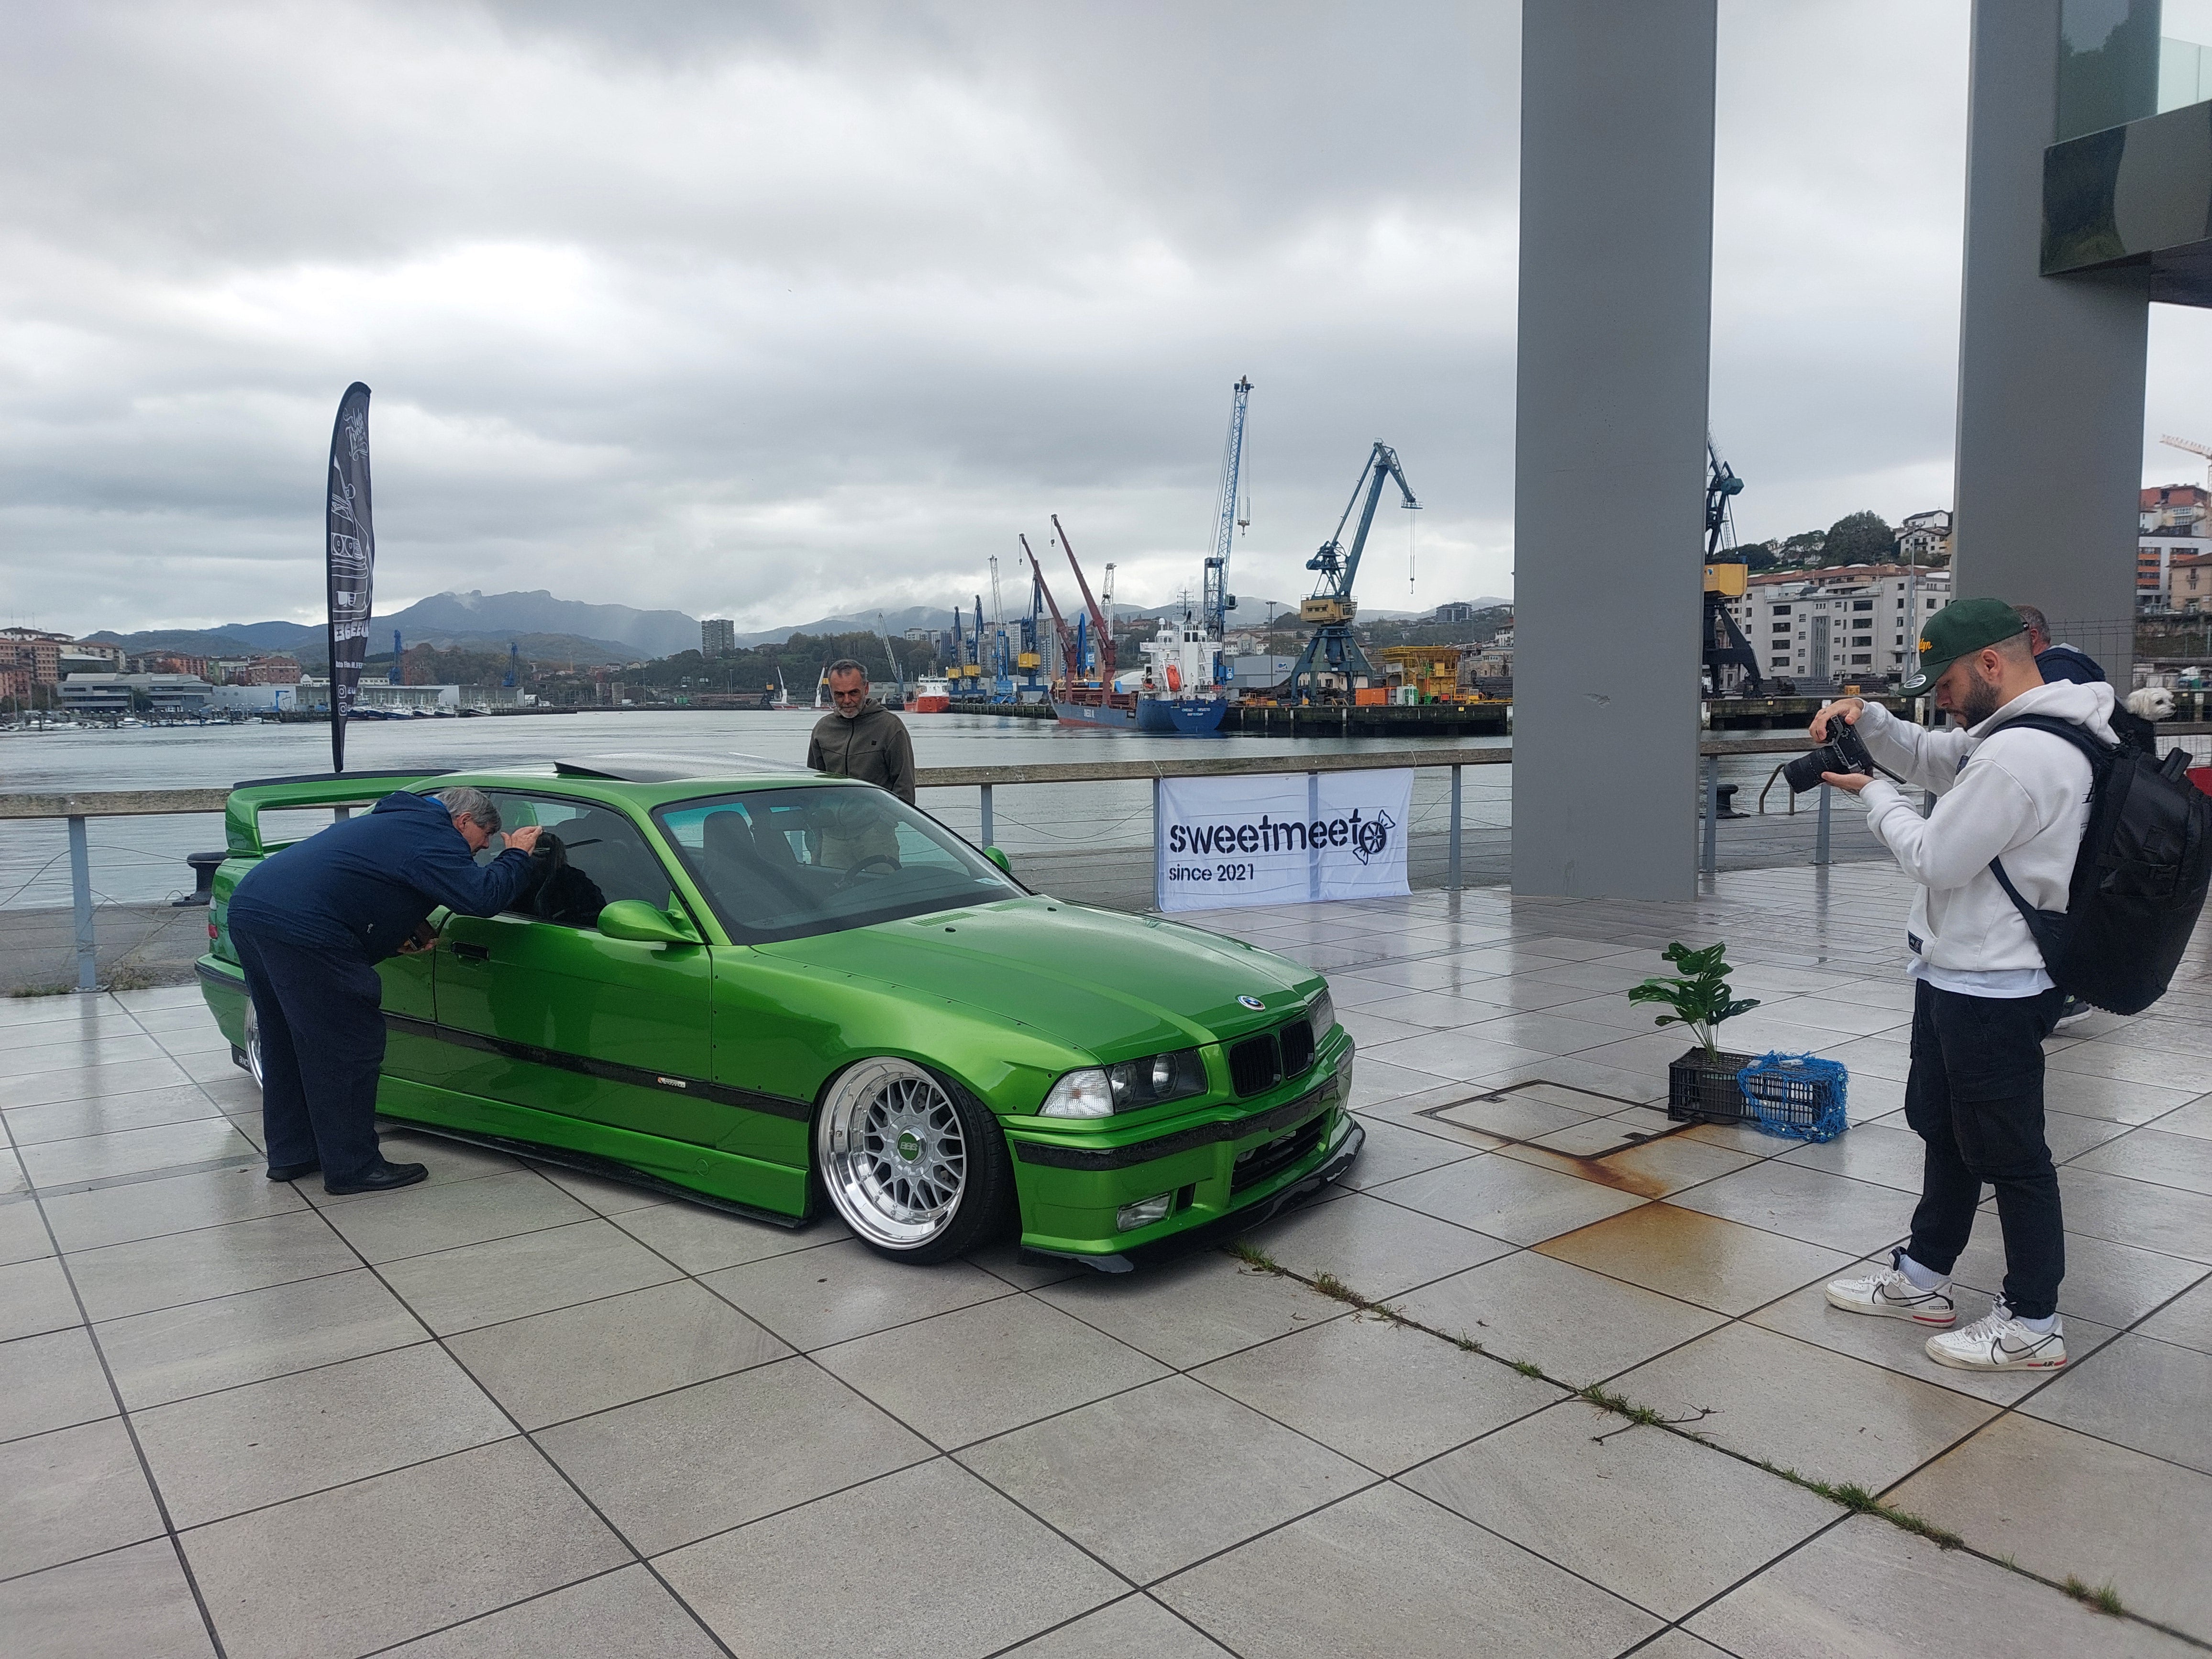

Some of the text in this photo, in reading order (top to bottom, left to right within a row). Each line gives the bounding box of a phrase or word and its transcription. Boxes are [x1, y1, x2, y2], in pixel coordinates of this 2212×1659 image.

[1170, 808, 1362, 854] sweetmeet
[1169, 863, 1253, 881] since 2021
[900, 1142, 918, 1151] BBS
